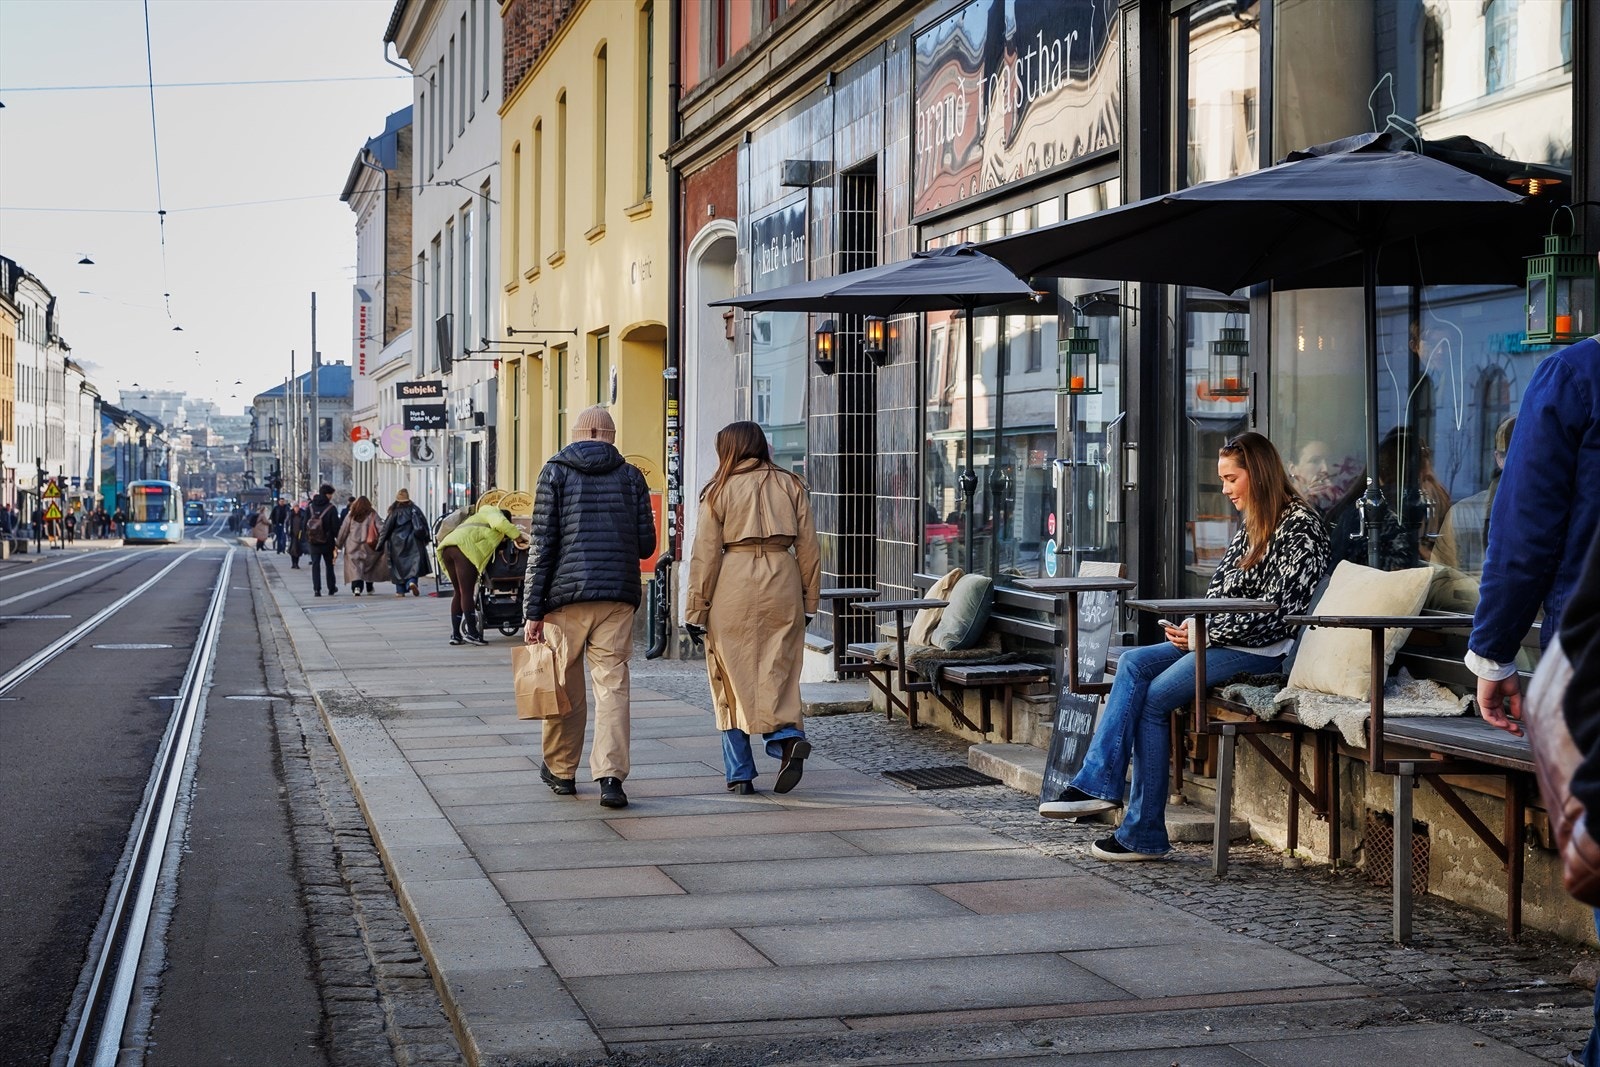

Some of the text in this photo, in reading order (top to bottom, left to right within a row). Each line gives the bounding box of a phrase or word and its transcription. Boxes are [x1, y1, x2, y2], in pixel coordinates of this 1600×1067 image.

[976, 29, 1079, 126] toastbar
[761, 230, 805, 275] kafé & bar
[402, 385, 437, 395] Subjekt
[1084, 605, 1102, 623] BAR
